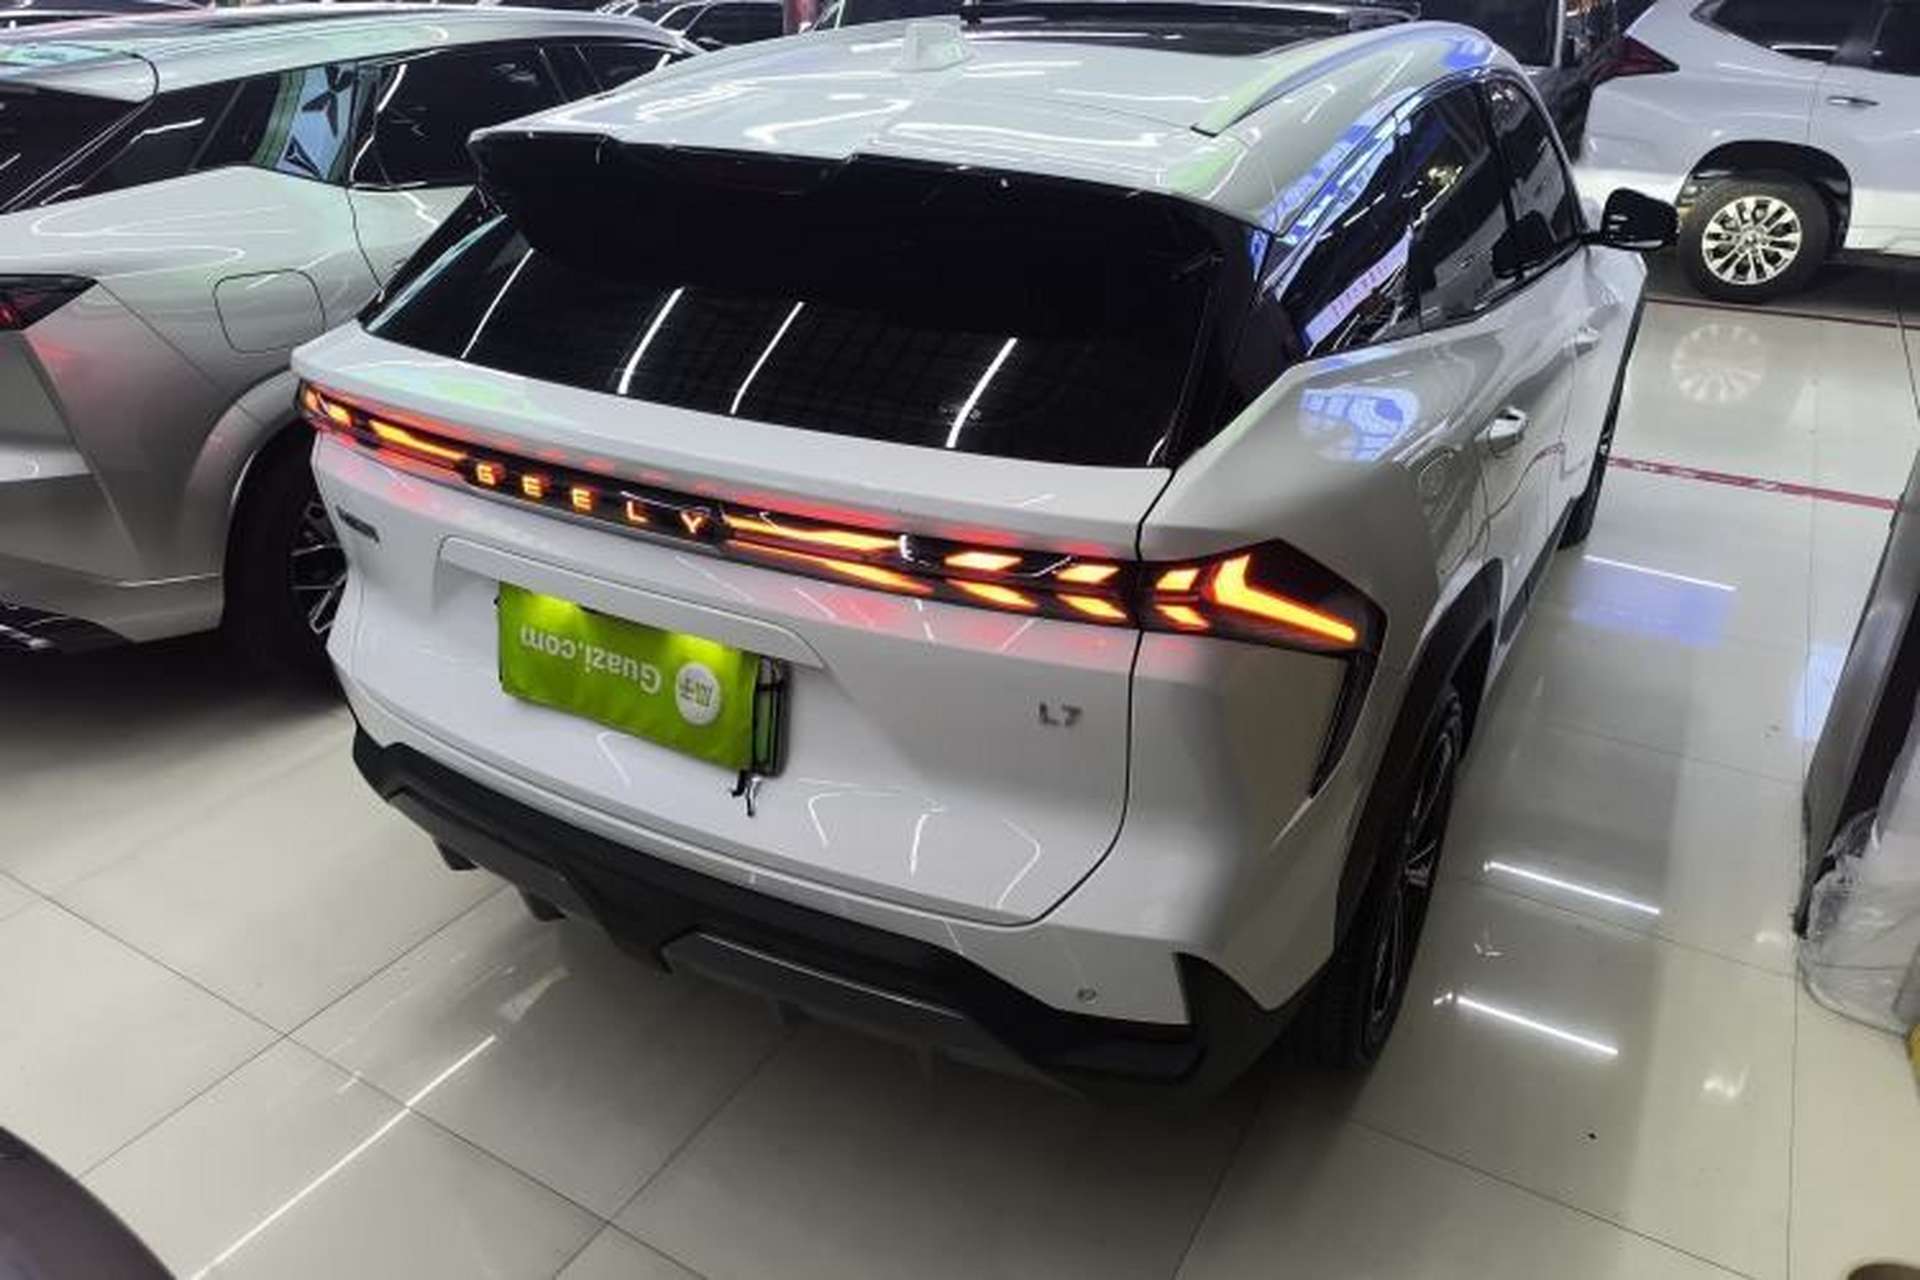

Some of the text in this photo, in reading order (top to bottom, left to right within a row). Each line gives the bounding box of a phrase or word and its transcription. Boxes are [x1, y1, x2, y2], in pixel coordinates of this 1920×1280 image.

[475, 462, 704, 534] GEELY
[519, 624, 662, 695] Guazi.com
[1039, 701, 1083, 728] L7
